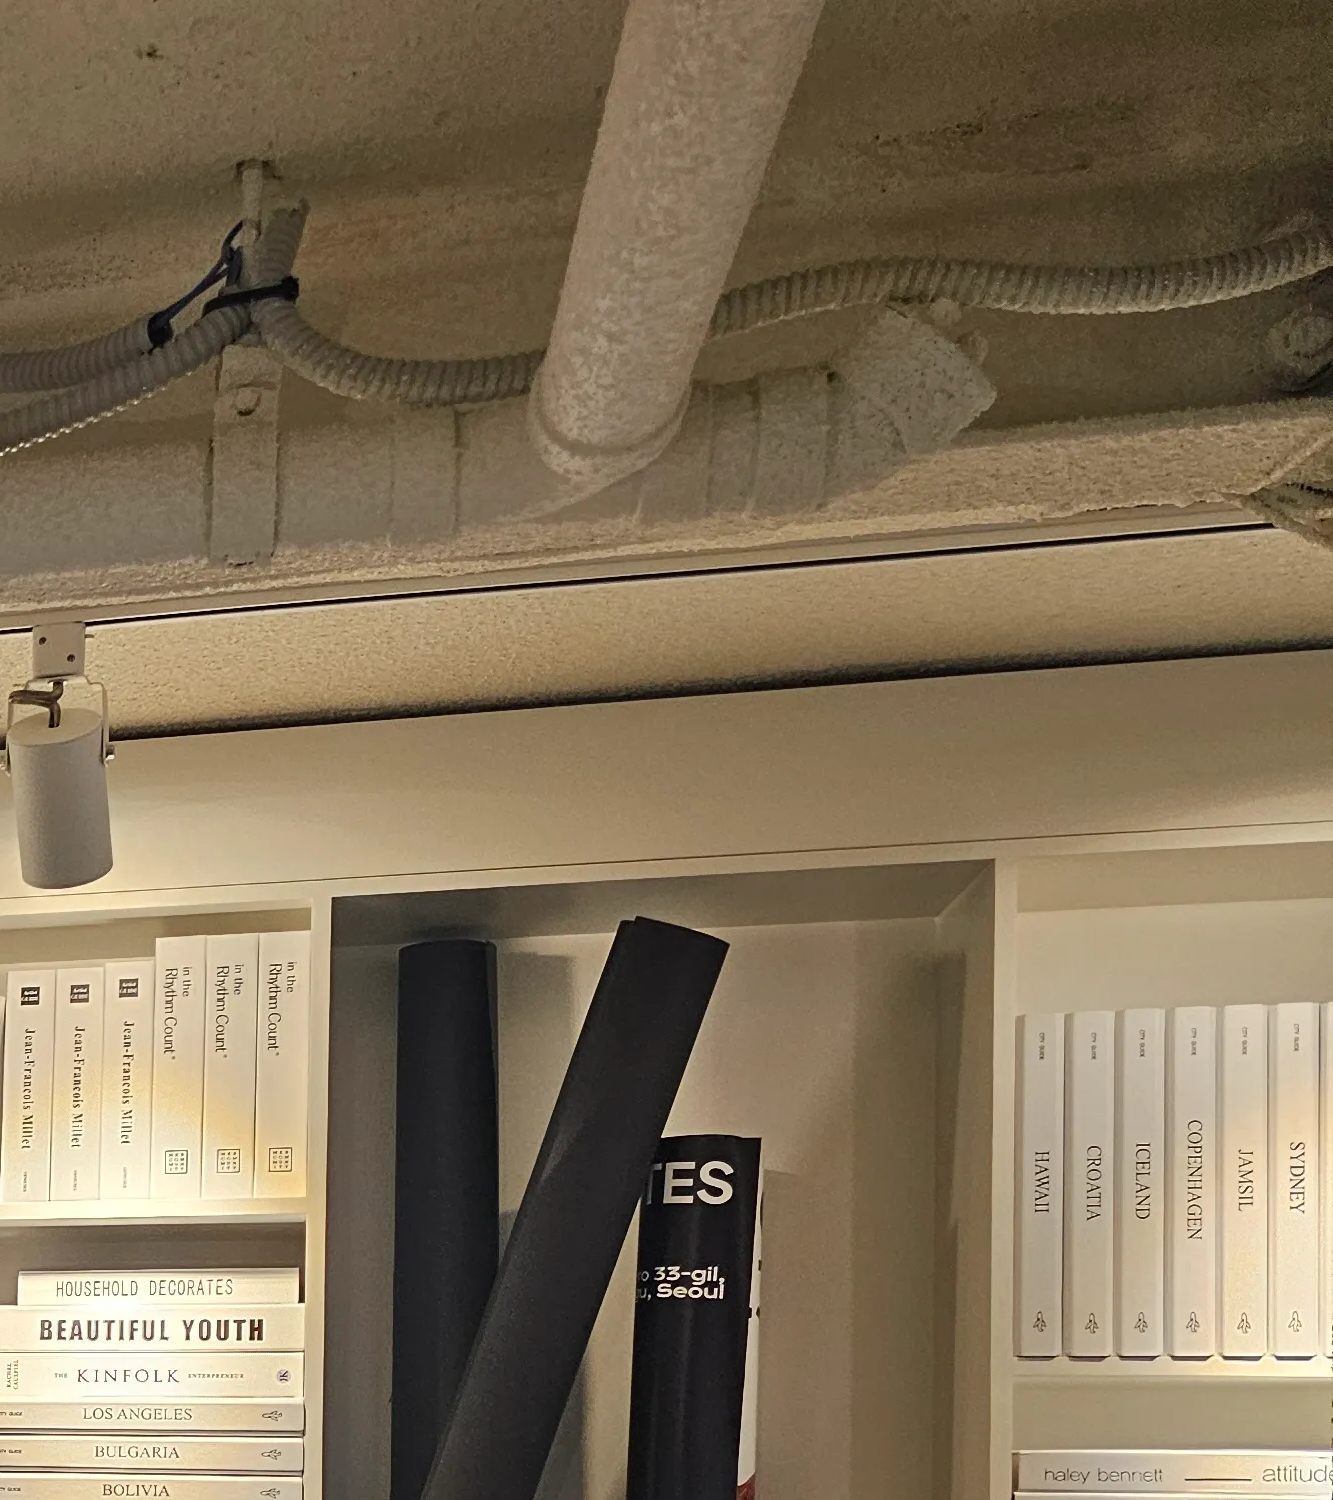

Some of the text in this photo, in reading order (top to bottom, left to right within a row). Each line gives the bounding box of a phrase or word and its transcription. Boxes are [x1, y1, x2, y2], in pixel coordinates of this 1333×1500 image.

[165, 969, 178, 1013] Rhythm
[183, 967, 191, 997] in the
[72, 1114, 83, 1147] Millet
[121, 1110, 132, 1143] Millet
[1035, 1152, 1049, 1212] HAWAII
[1087, 1146, 1101, 1220] CROATIA
[1136, 1143, 1150, 1219] ICELAND
[1187, 1120, 1202, 1239] COPENHAGEN
[1238, 1149, 1253, 1211] JAMSIL
[1290, 1142, 1305, 1213] SYDNEY
[57, 1279, 232, 1297] HOUSEHOLD DECORATES
[654, 1266, 725, 1286] 33-gil,
[657, 1282, 724, 1299] Seoul
[40, 1319, 263, 1341] BEAUTIFUL YOUTH
[78, 1369, 179, 1382] KINFOLK
[84, 1408, 192, 1420] LOS ANGELES
[95, 1446, 179, 1458] BULGARIA
[103, 1484, 169, 1496] BOLIVIA
[1045, 1468, 1090, 1484] haley
